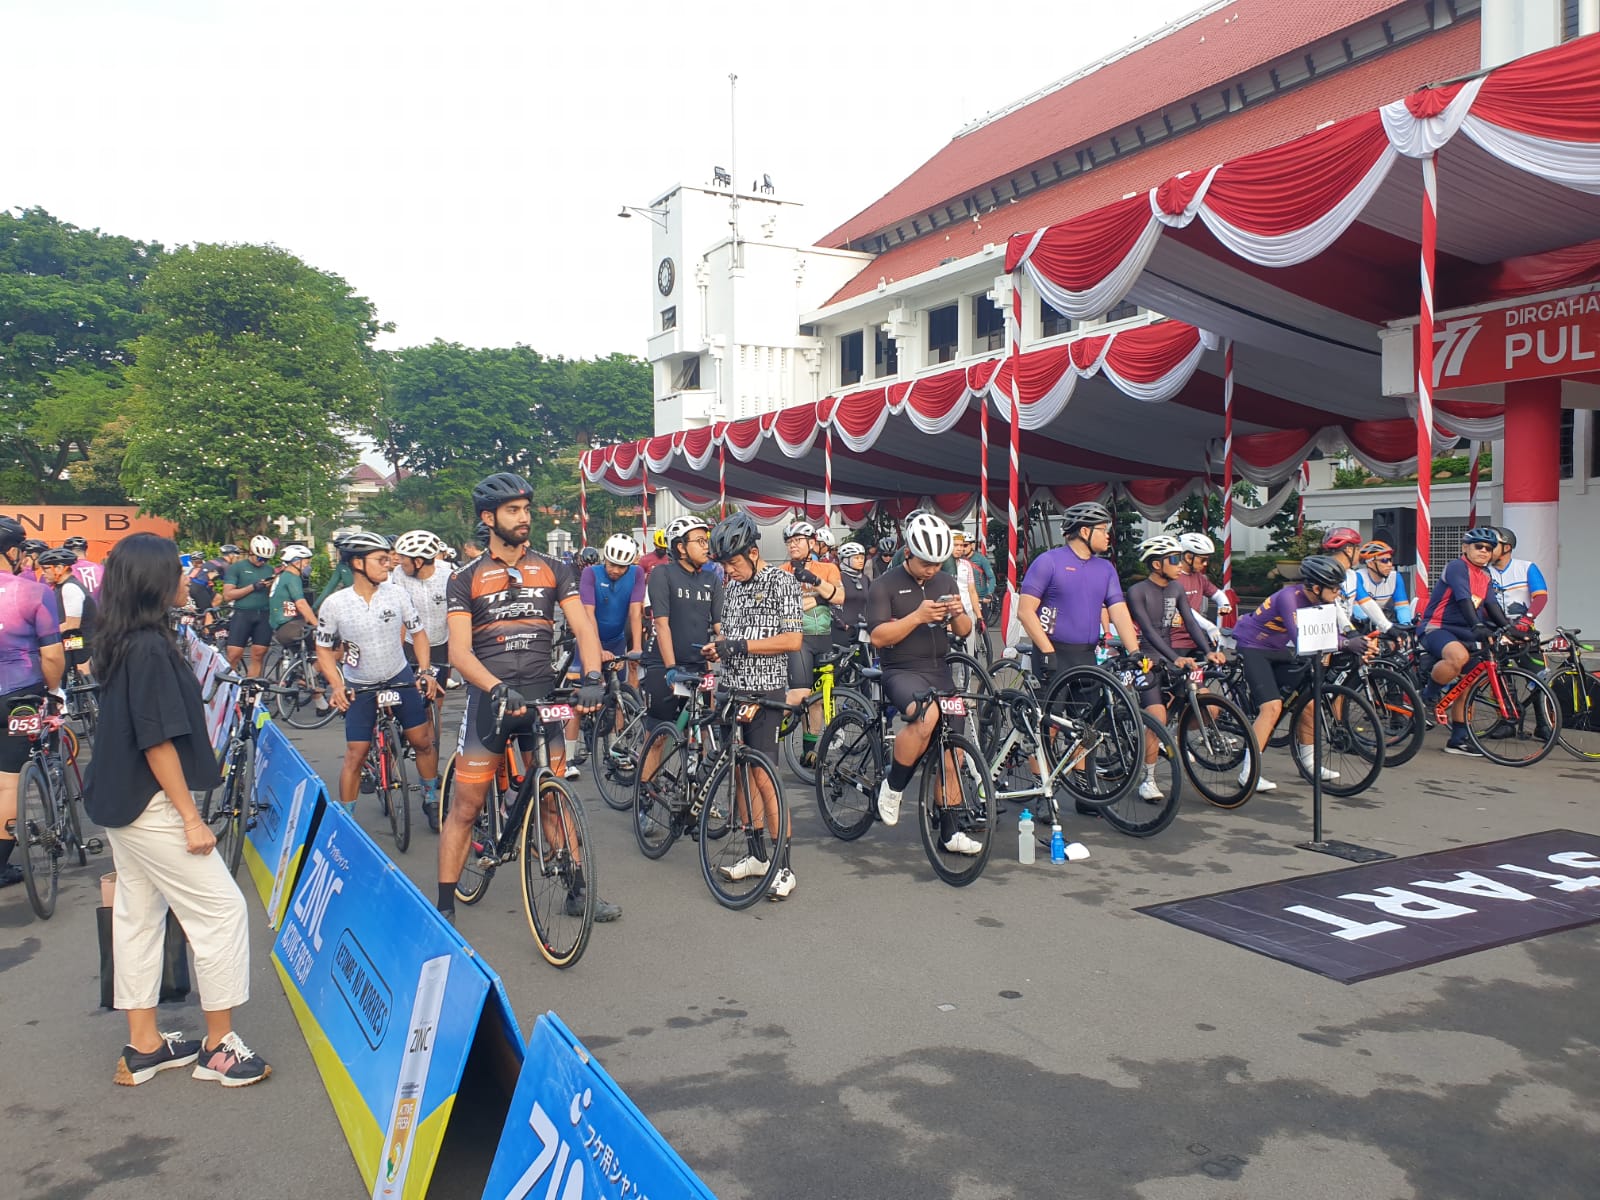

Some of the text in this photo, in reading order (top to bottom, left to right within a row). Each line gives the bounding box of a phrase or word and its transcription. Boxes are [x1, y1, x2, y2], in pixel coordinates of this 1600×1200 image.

[1505, 295, 1600, 327] DIRGAHA
[1505, 325, 1596, 370] PUL
[1303, 622, 1334, 636] 100 KM
[378, 691, 400, 704] 008
[940, 699, 962, 711] 006
[541, 706, 570, 719] 003
[9, 717, 39, 732] 053
